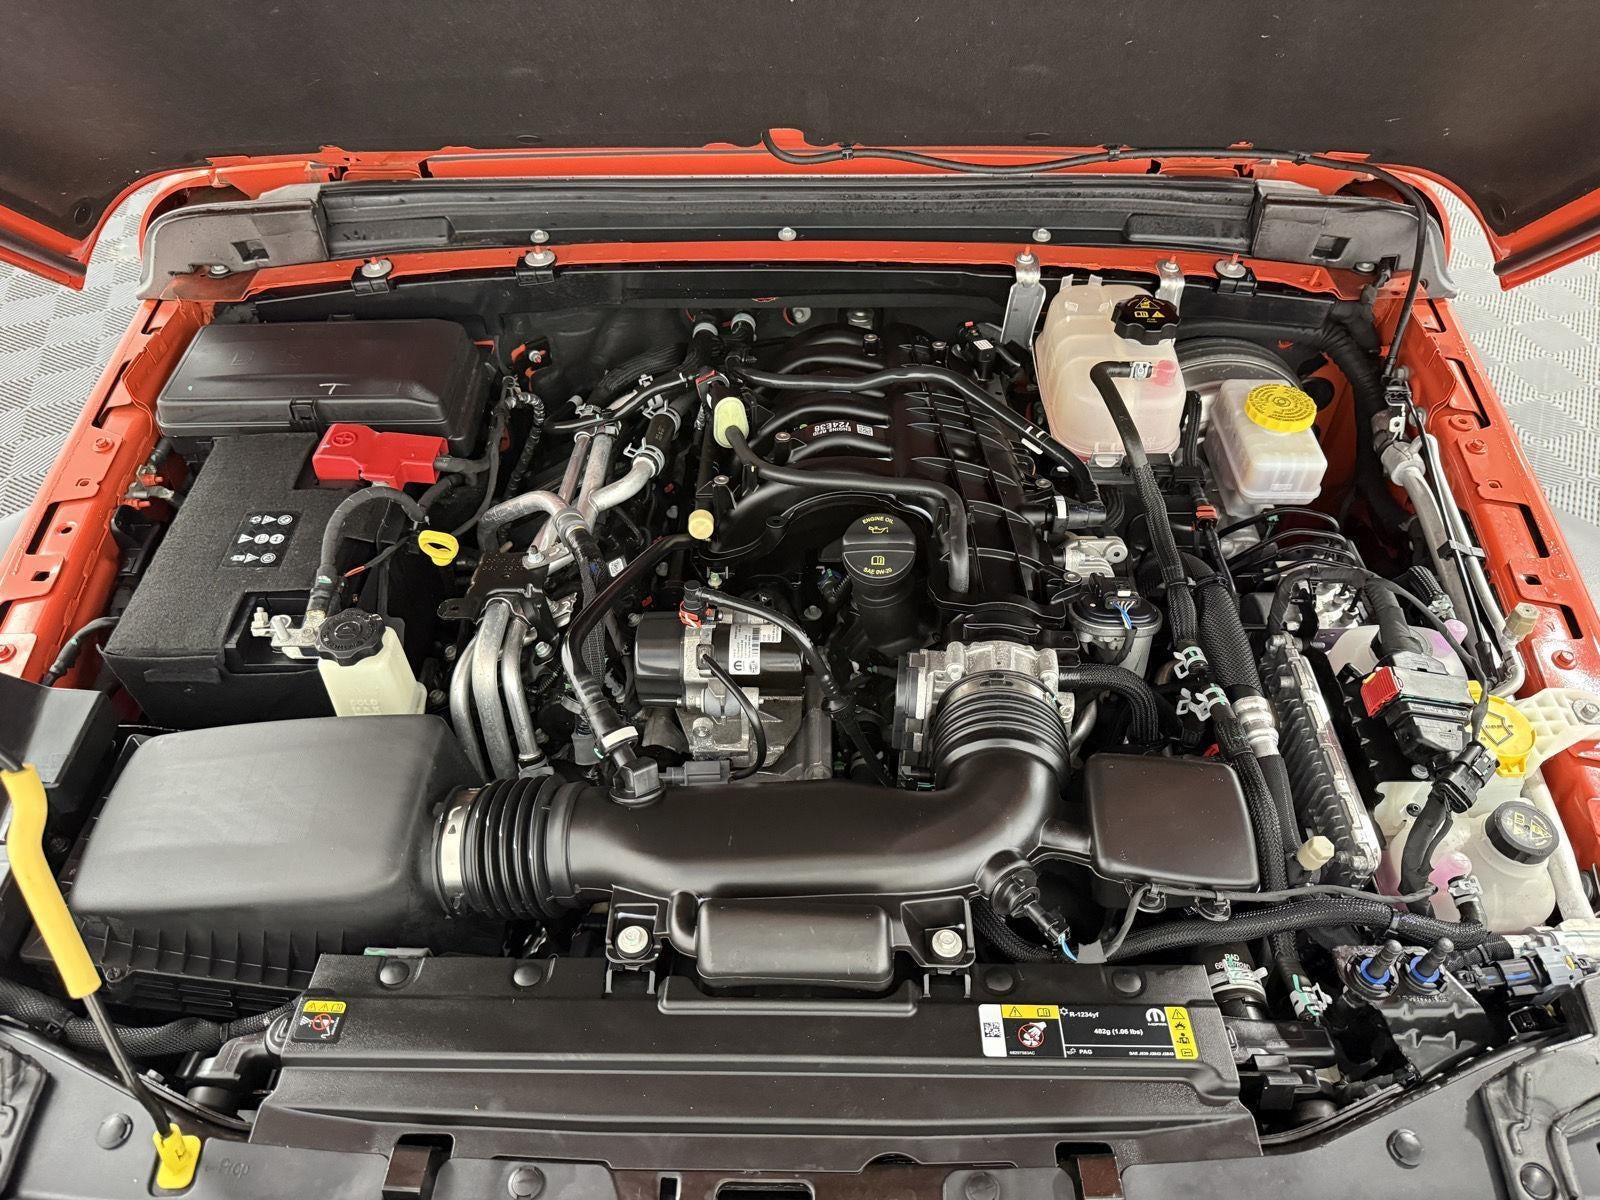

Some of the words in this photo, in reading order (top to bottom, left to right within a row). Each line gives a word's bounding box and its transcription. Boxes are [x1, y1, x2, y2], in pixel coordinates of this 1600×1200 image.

[862, 516, 884, 525] ENGINE
[885, 517, 894, 525] OIL
[863, 567, 875, 575] SAE
[1069, 1011, 1099, 1019] R-1234yf
[1129, 1028, 1144, 1036] lbs)
